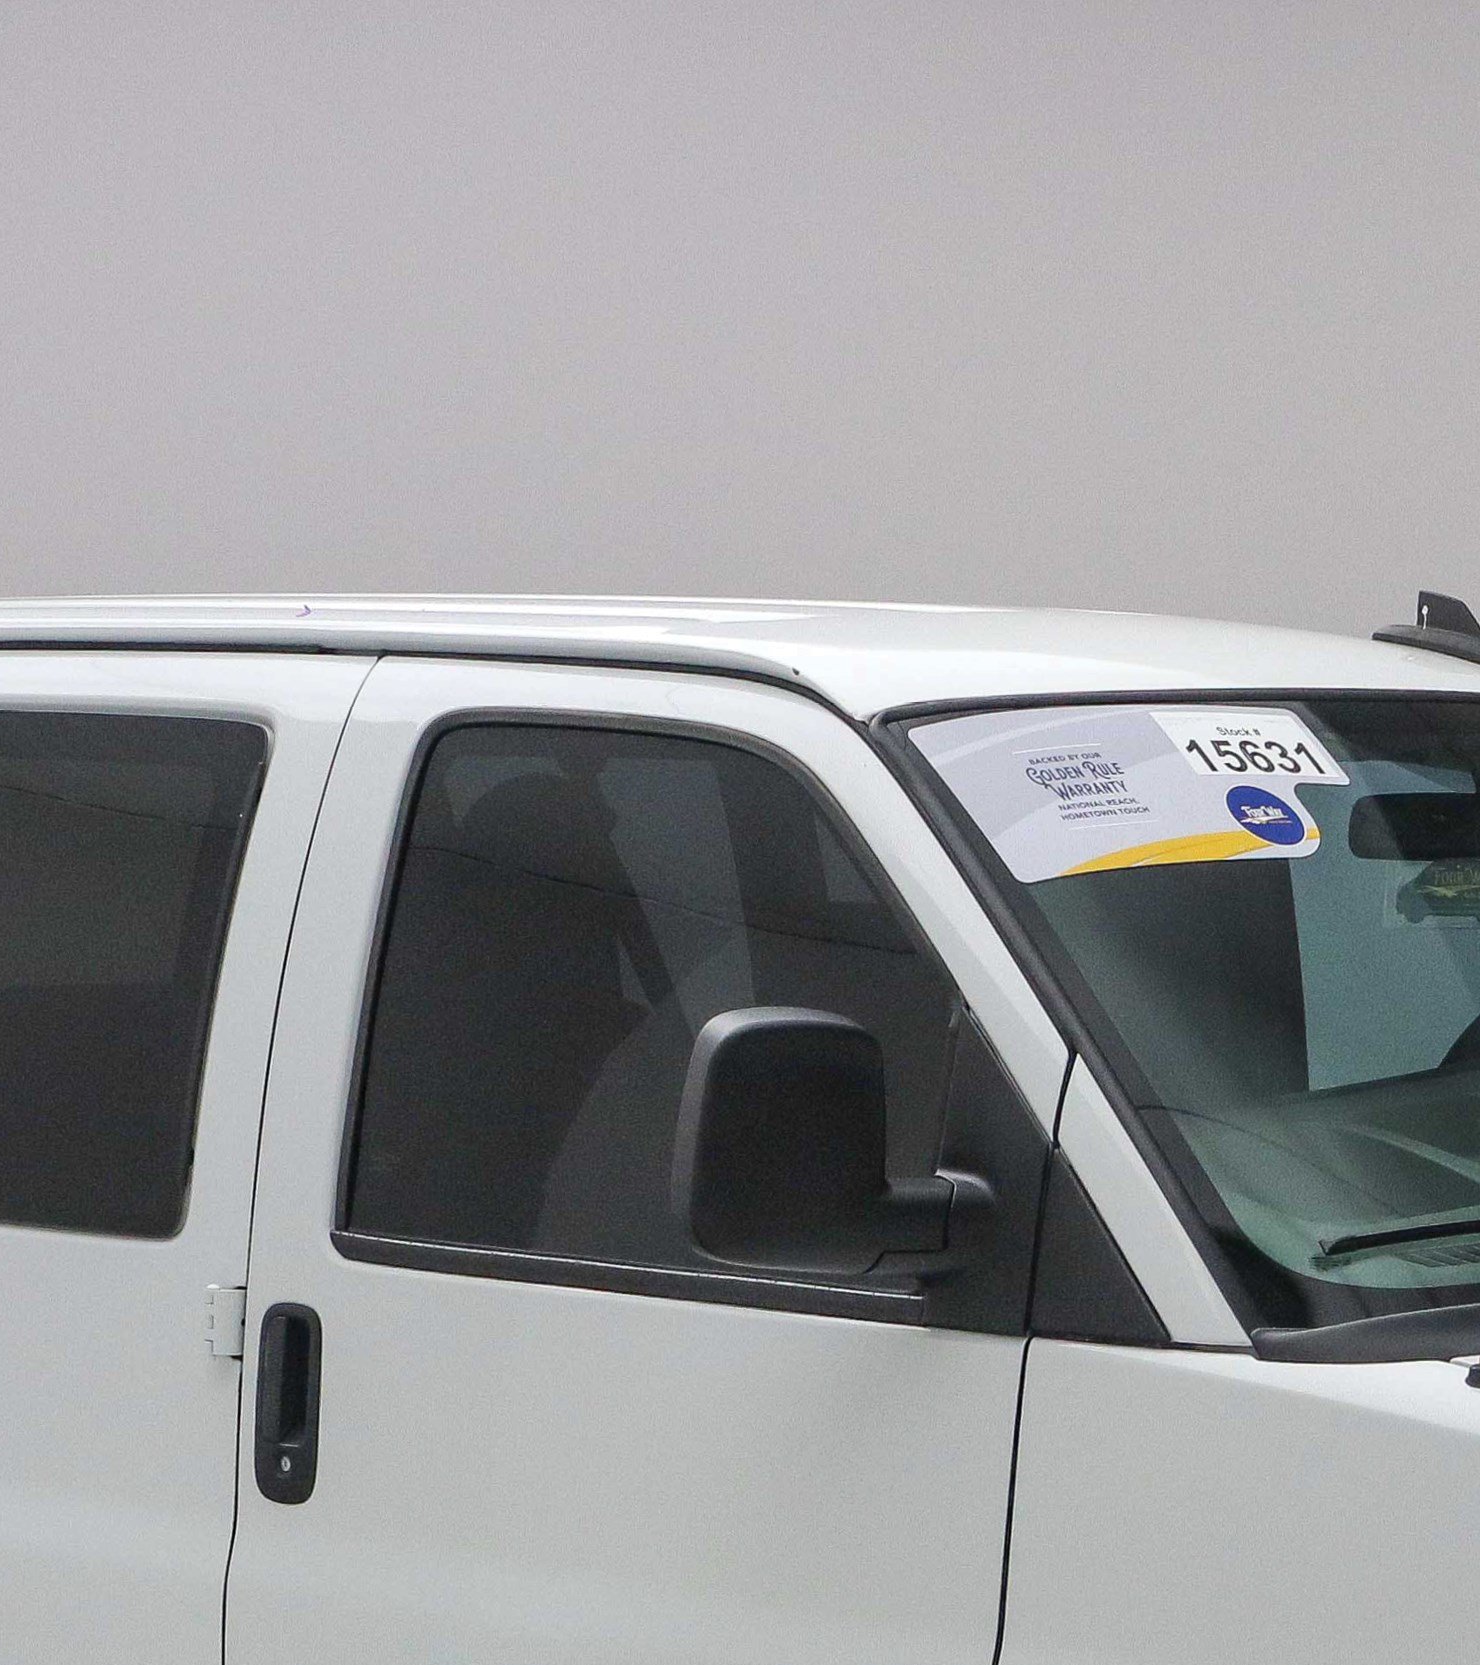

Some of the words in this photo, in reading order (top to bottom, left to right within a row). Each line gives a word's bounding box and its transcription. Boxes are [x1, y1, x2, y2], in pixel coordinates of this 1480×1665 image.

[1216, 727, 1251, 736] Stock
[1028, 755, 1065, 765] BACKED
[1081, 752, 1102, 760] OUR
[1186, 739, 1325, 774] 15631
[1026, 767, 1086, 786] GOLDEN
[1082, 761, 1124, 779] RULE
[1044, 780, 1128, 801] WARRANTY
[1058, 800, 1106, 812] NATIONAL
[1060, 808, 1117, 821] HOMETOWN
[1119, 806, 1150, 815] TOUCH
